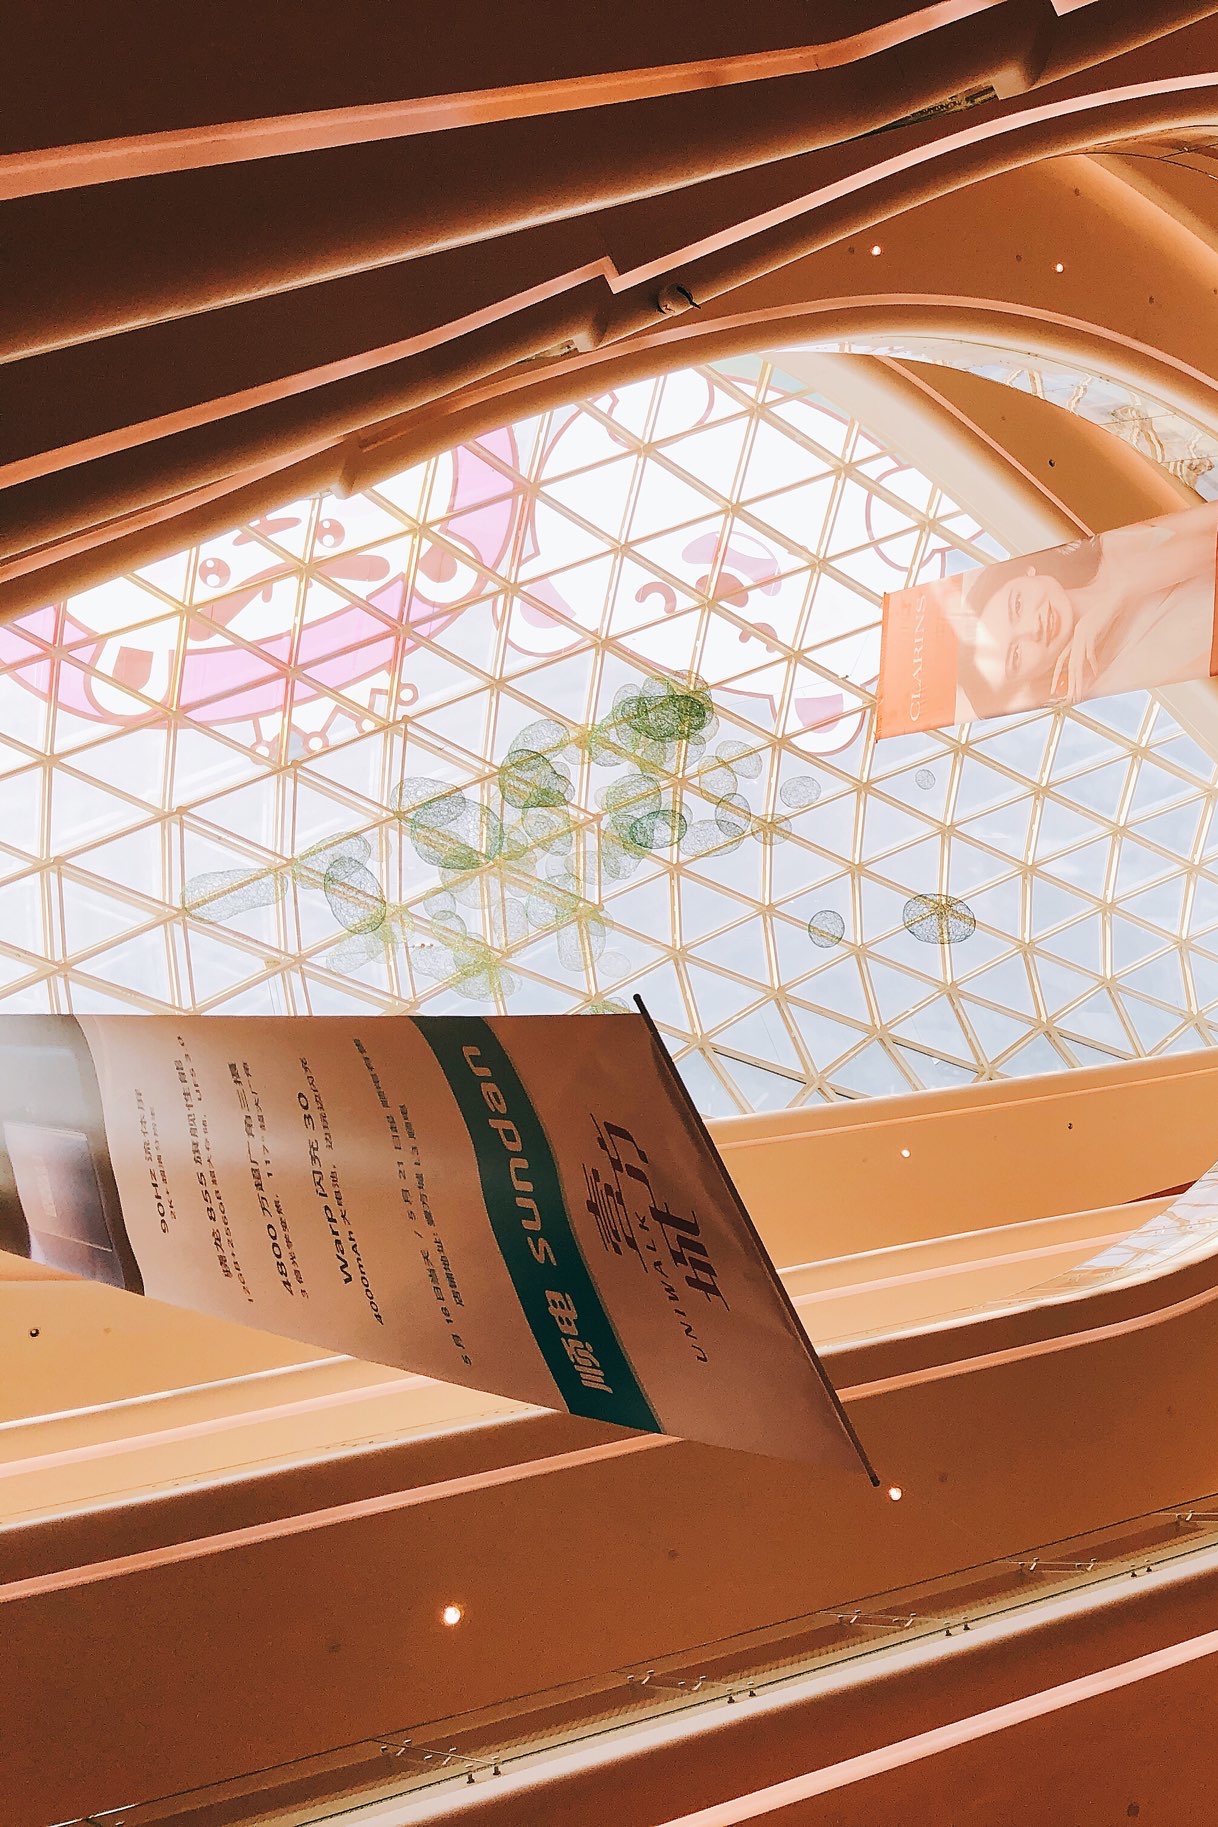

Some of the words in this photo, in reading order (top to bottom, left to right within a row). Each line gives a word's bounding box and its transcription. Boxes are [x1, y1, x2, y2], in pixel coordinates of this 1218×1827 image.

[910, 595, 926, 722] CLARINS
[228, 1062, 278, 1219] 万超广角三摄
[297, 1091, 319, 1132] 30
[308, 1138, 335, 1201] 闪充
[462, 1045, 557, 1266] sundan
[149, 1167, 170, 1233] 90Hz
[196, 1171, 220, 1224] 855
[210, 1227, 233, 1279] 骁龙
[265, 1222, 295, 1296] 4800
[322, 1205, 357, 1285] Warp
[342, 1228, 384, 1325] 4000mAh
[636, 1211, 708, 1363] UNIWALK
[545, 1290, 613, 1394] 顺电
